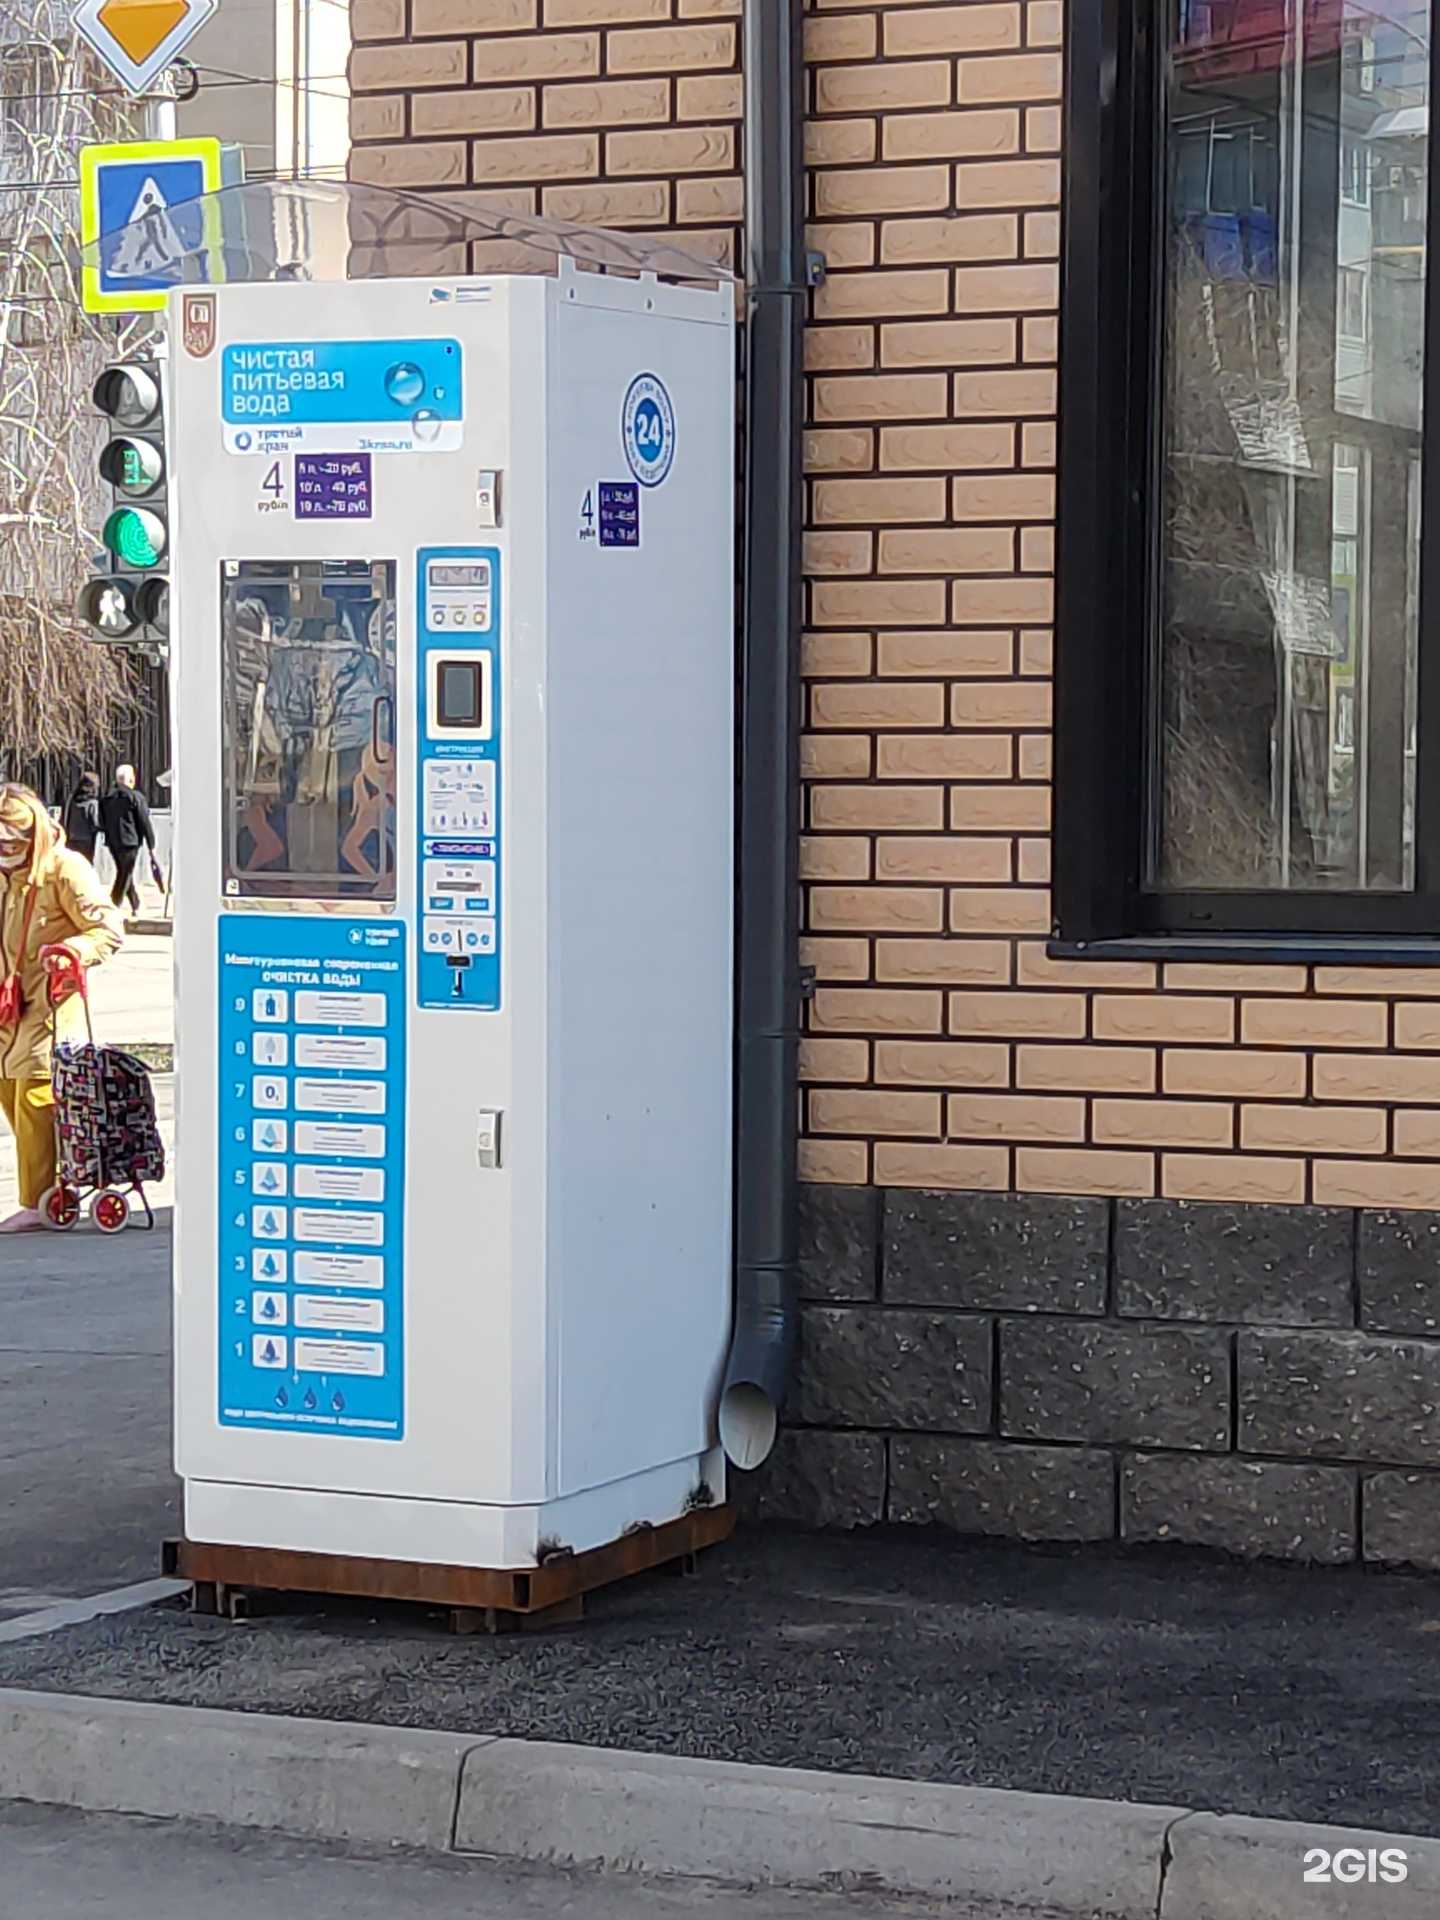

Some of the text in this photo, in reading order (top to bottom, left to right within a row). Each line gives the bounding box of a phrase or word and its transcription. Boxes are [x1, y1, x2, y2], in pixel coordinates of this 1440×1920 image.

[231, 349, 314, 369] чистая
[232, 371, 345, 391] питьевая
[232, 394, 291, 417] вода
[636, 413, 661, 447] 24
[262, 461, 284, 499] 4
[581, 489, 594, 526] 4
[234, 1083, 246, 1097] 7
[234, 1127, 246, 1141] 6
[234, 1170, 246, 1184] 5
[234, 1213, 246, 1227] 4
[234, 1256, 246, 1270] 3
[234, 1299, 246, 1313] 2
[234, 1342, 246, 1356] 1
